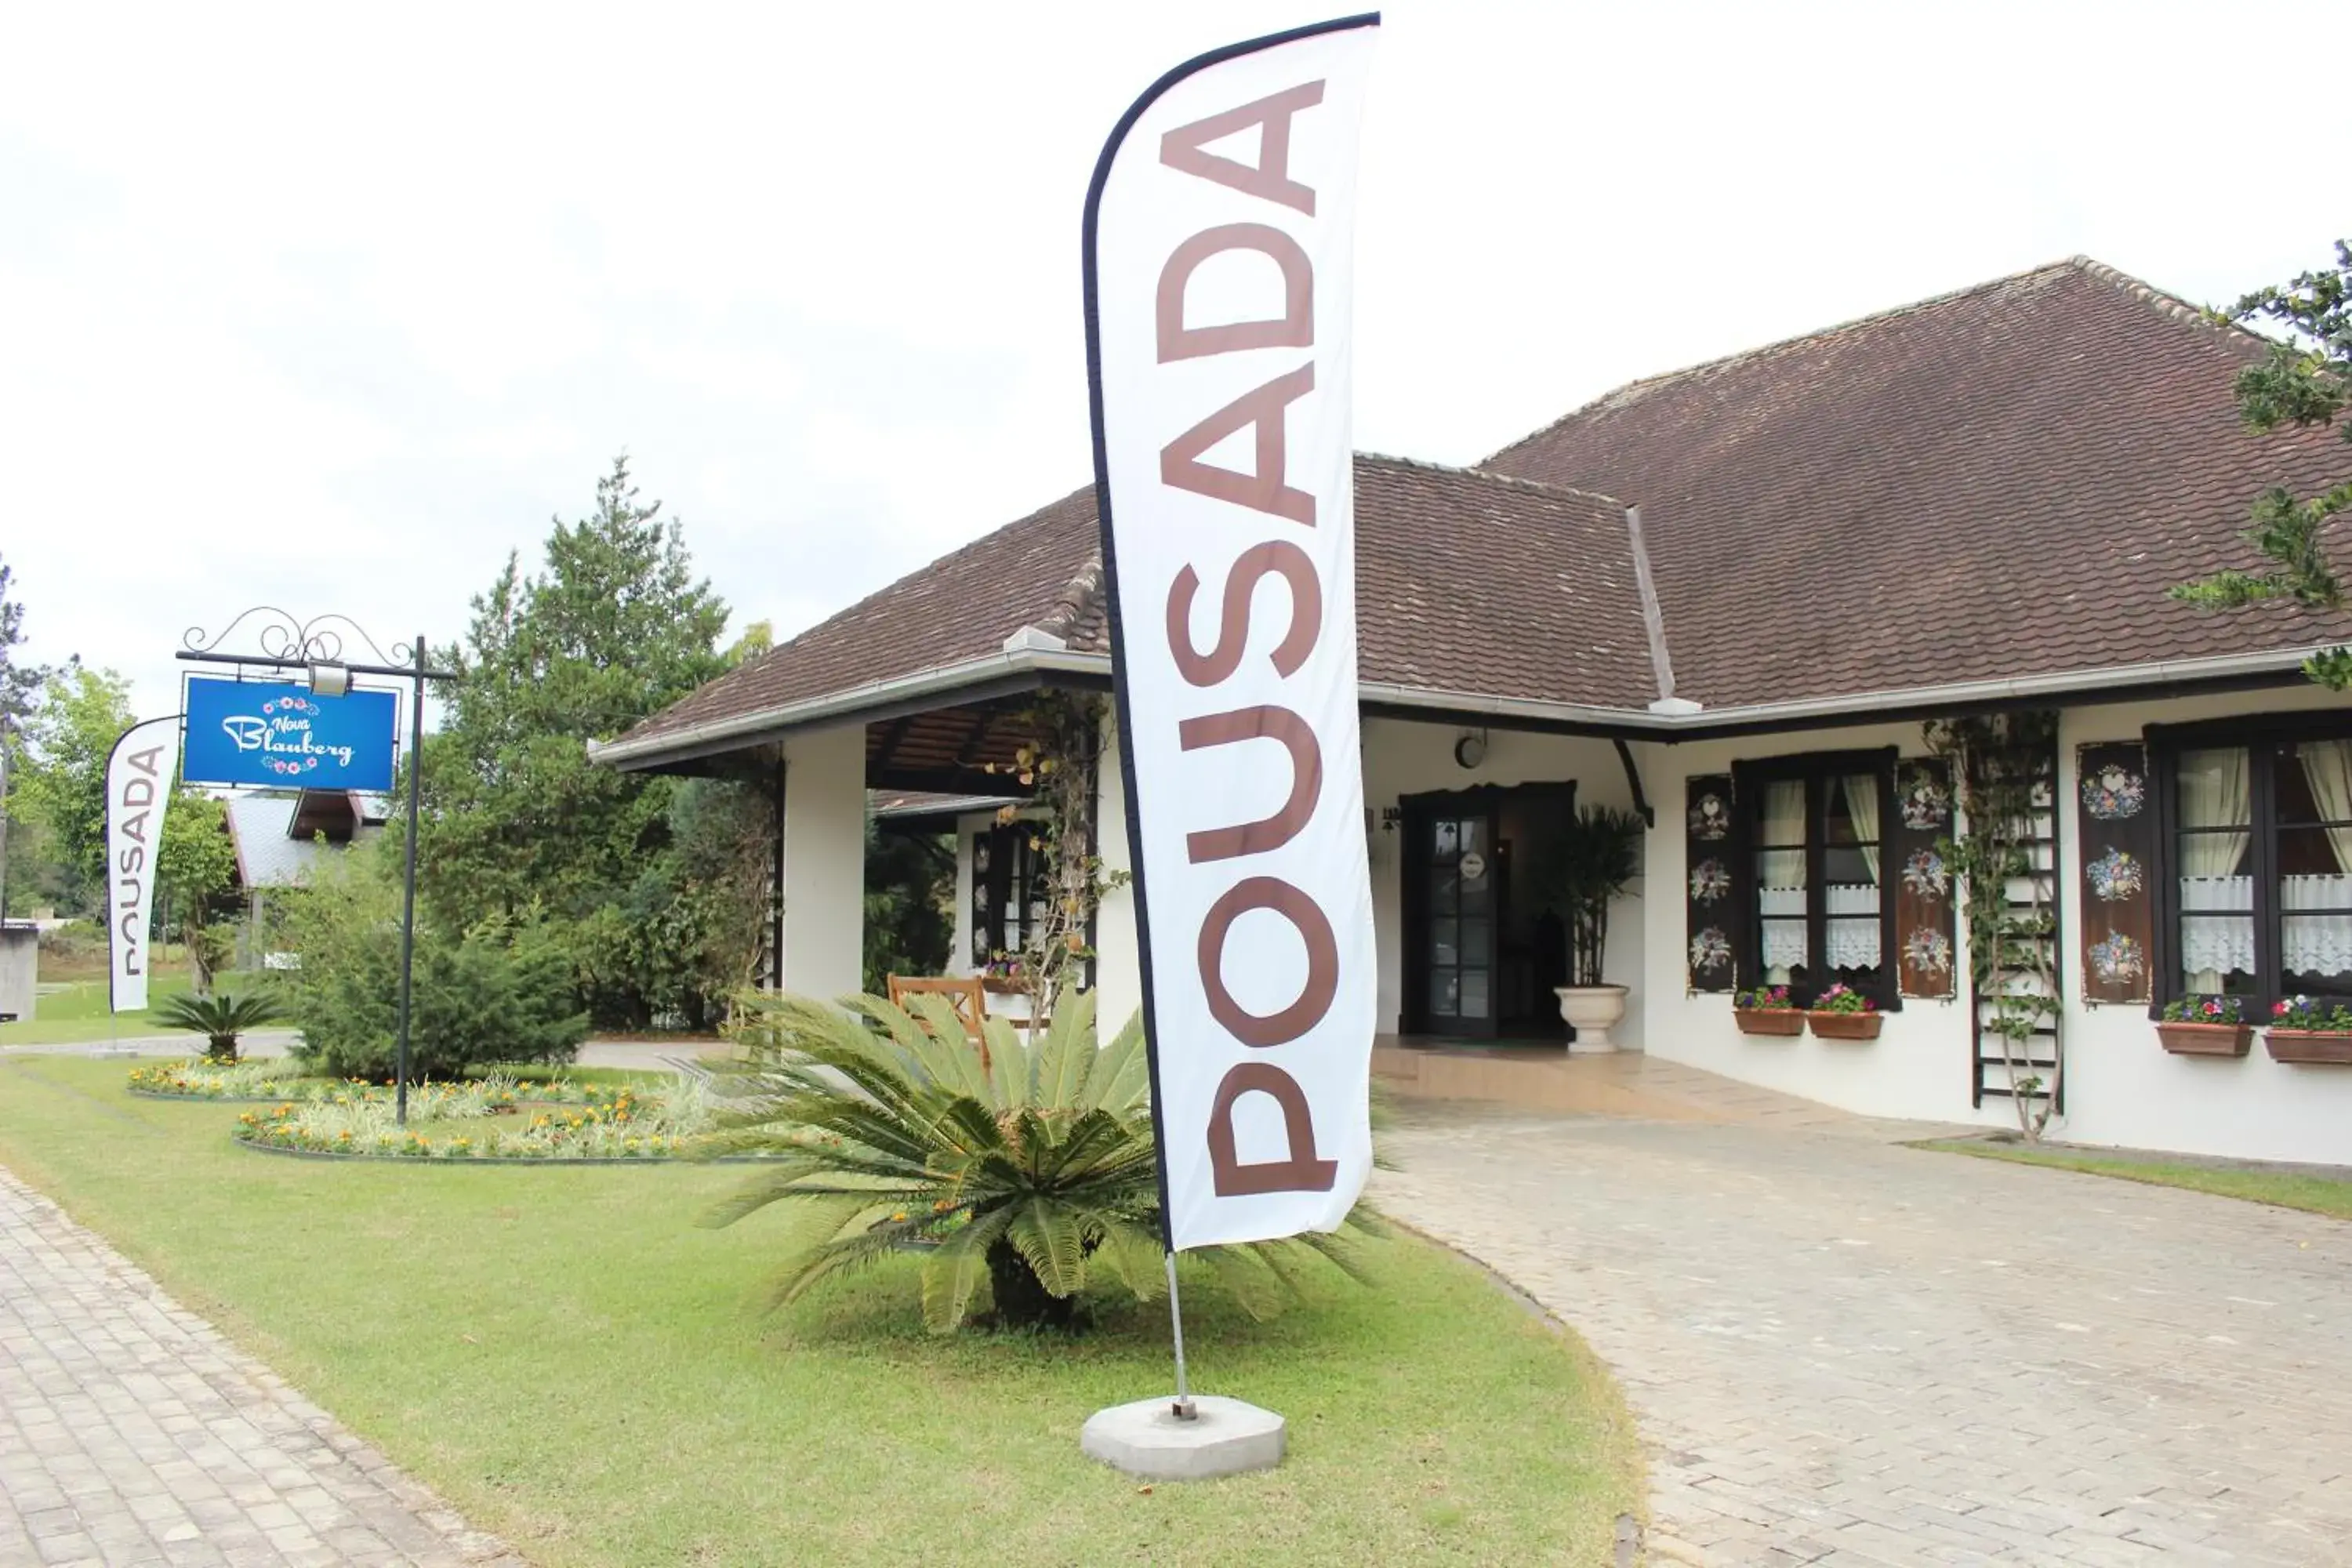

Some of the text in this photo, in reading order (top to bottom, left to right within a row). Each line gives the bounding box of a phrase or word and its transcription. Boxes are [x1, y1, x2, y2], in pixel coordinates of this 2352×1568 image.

[1156, 79, 1339, 1197] POUSADA
[222, 715, 355, 767] Blauberg
[272, 715, 310, 733] Nova
